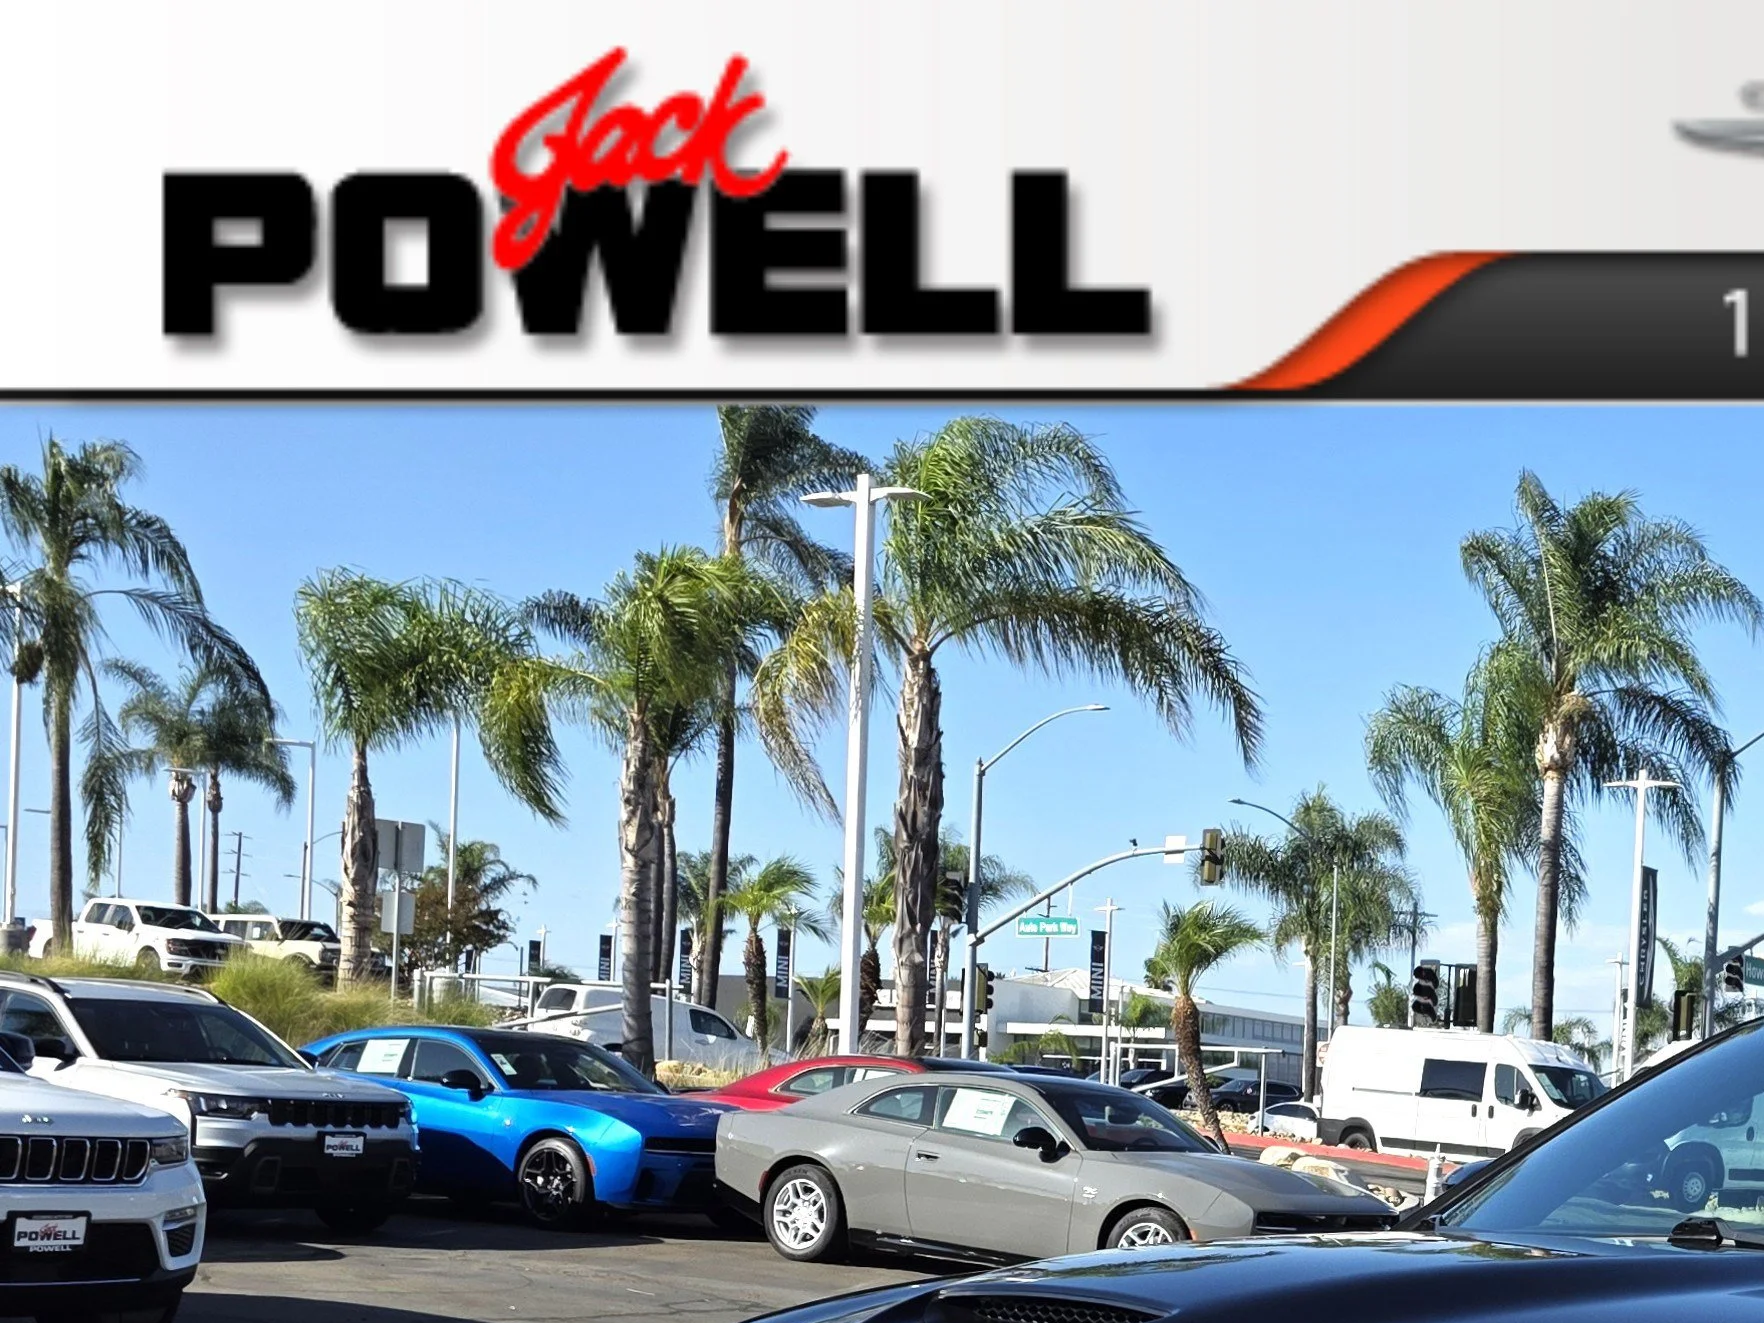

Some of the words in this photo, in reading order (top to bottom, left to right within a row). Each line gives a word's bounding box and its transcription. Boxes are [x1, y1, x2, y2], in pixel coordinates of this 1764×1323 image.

[777, 955, 789, 988] MINI
[1091, 962, 1104, 999] MINI
[16, 1230, 81, 1241] POWELL
